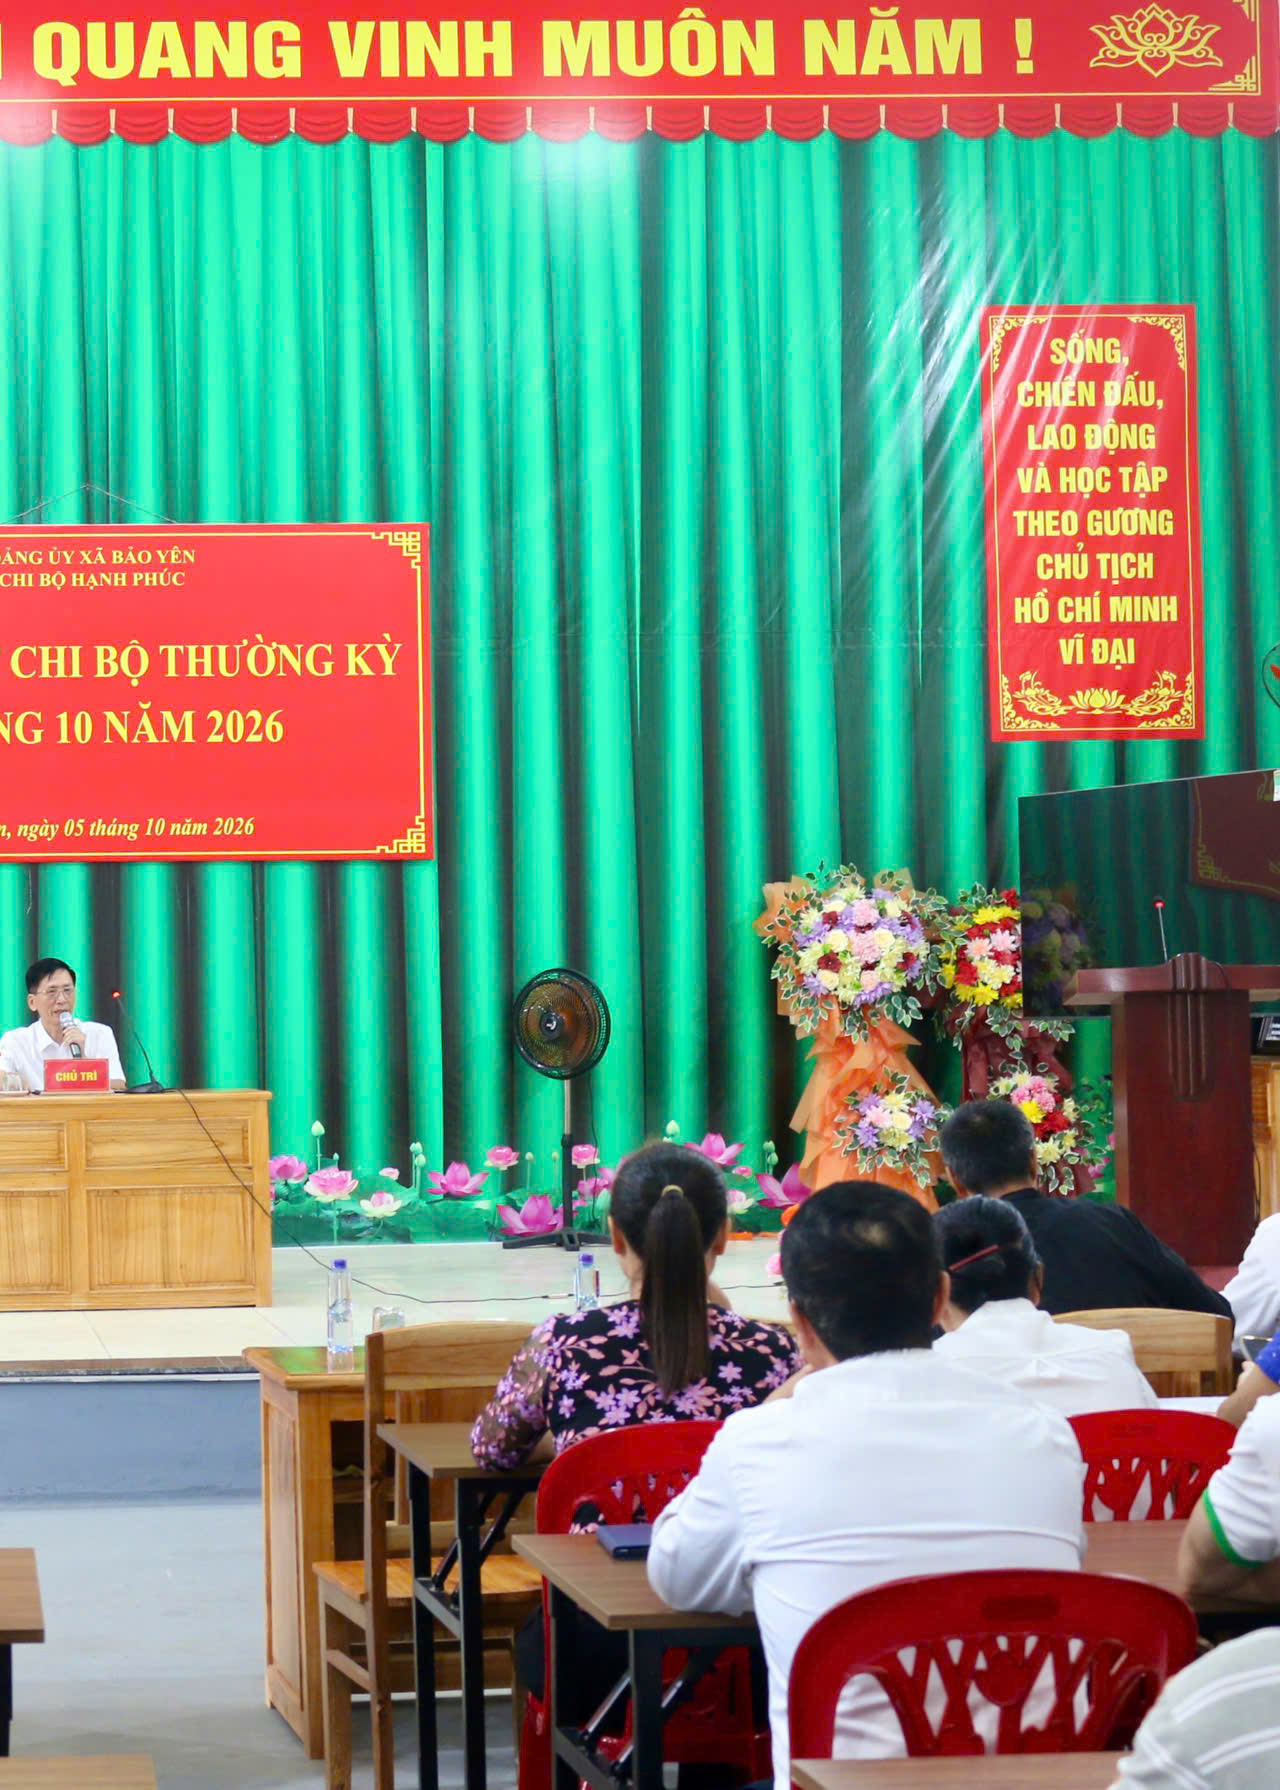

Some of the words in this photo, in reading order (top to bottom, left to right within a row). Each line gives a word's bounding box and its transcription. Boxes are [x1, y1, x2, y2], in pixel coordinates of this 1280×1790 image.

[34, 16, 304, 86] QUANG
[328, 19, 513, 80] VINH
[540, 8, 776, 78] MUÔN
[803, 5, 984, 77] NĂM
[1016, 18, 1034, 74] !
[1049, 328, 1130, 367] SỐNG,
[1103, 371, 1164, 410] ĐẤU,
[1027, 424, 1077, 450] LAO
[1085, 421, 1156, 457] ĐỘNG
[1017, 461, 1052, 493] VÀ
[1059, 465, 1112, 498] HỌC
[1118, 461, 1168, 498] TẬP
[1013, 508, 1080, 538] THEO
[1086, 507, 1175, 537] GƯƠNG
[48, 546, 75, 565] ỦY
[80, 547, 108, 564] XÃ
[112, 545, 153, 564] BẢO
[157, 544, 196, 564] YÊN
[1036, 542, 1088, 580] CHỦ
[1096, 552, 1155, 584] TỊCH
[40, 569, 67, 591] BỘ
[72, 571, 128, 590] HẠNH
[133, 567, 184, 587] PHÚC
[1014, 588, 1049, 623] HỒ
[1056, 592, 1102, 624] CHÍ
[1109, 594, 1179, 622] MINH
[10, 645, 84, 680] CHI
[96, 640, 152, 688] BỘ
[160, 634, 336, 680] THƯỜNG
[344, 632, 402, 678] KỲ
[1059, 633, 1086, 665] VĨ
[1091, 637, 1136, 670] ĐẠI
[58, 712, 95, 744] 10
[104, 701, 196, 744] NĂM
[207, 709, 284, 744] 2026
[16, 818, 61, 843] ngày
[64, 818, 86, 838] 05
[87, 818, 140, 840] tháng
[143, 816, 167, 838] 10
[169, 816, 208, 837] năm
[212, 816, 256, 836] 2026
[56, 1069, 78, 1082] CHỦ
